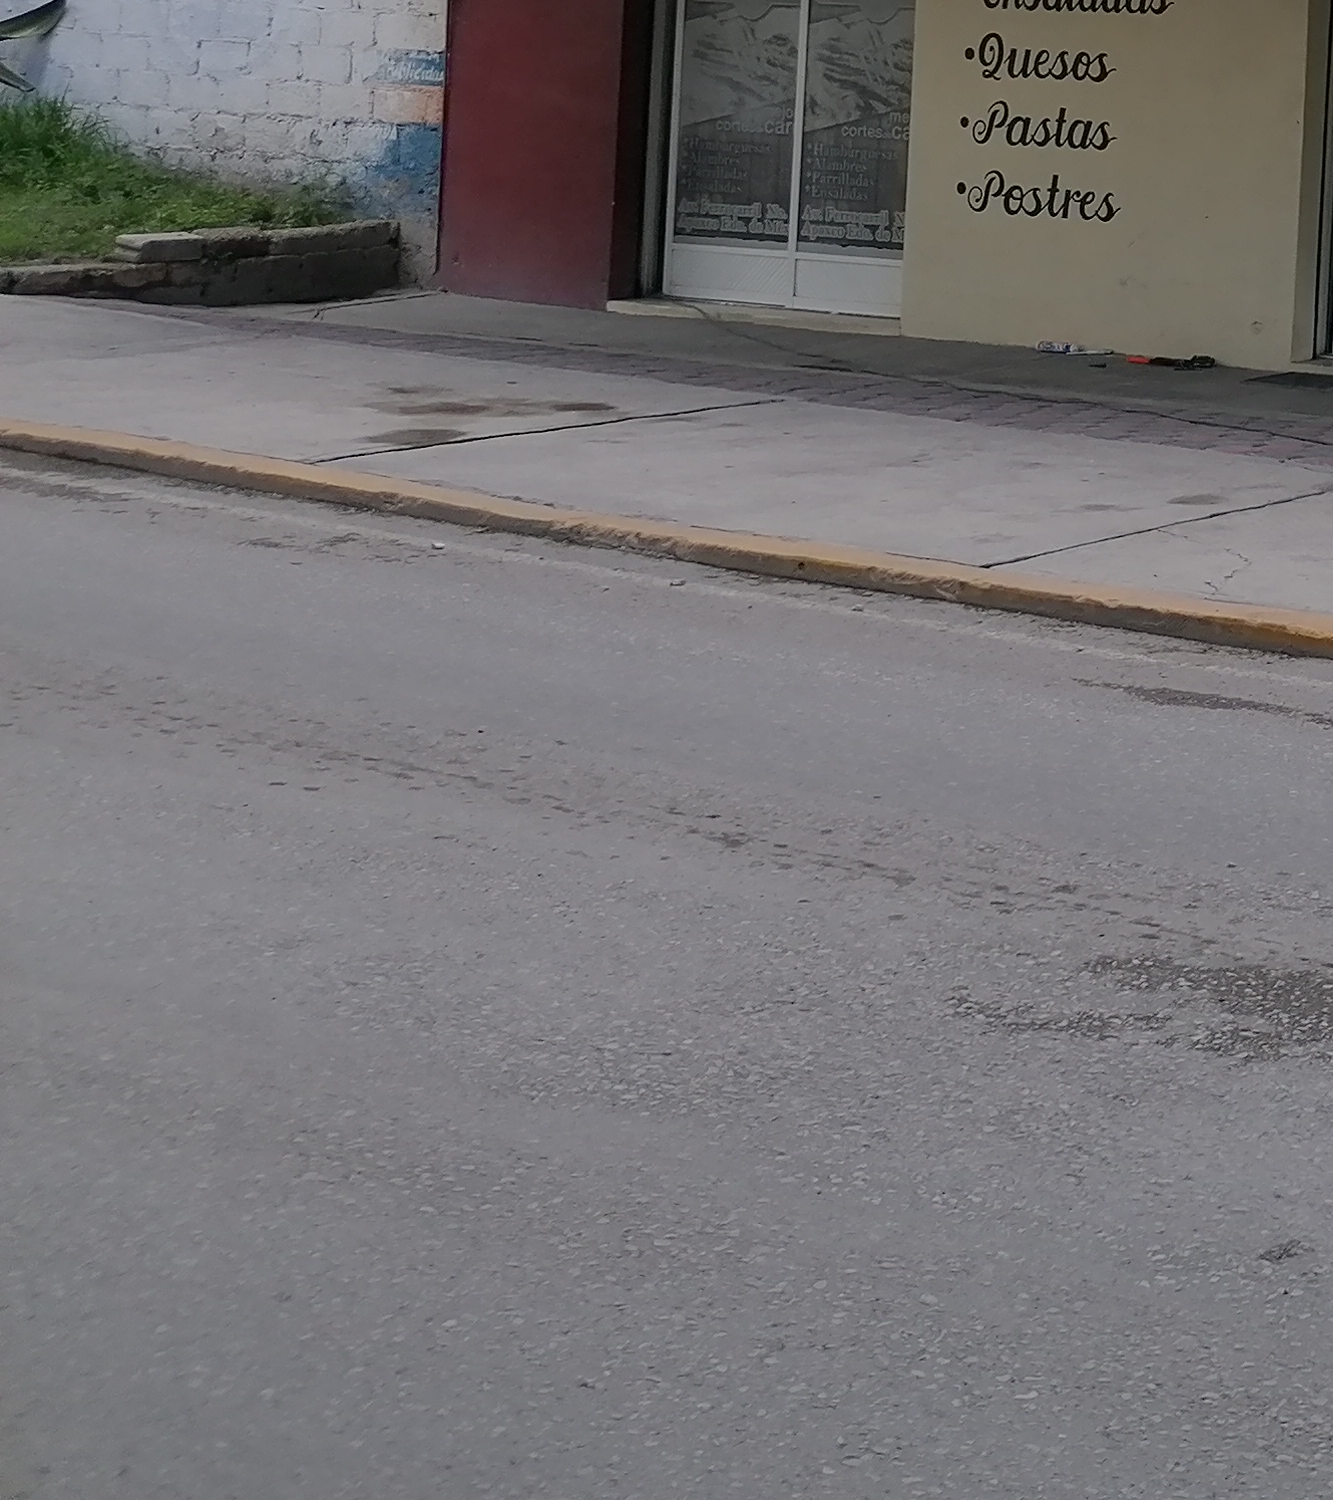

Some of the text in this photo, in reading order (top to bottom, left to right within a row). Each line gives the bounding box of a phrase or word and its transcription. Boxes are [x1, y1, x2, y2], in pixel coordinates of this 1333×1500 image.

[978, 32, 1117, 83] Quesos
[841, 125, 882, 139] cortes
[971, 101, 1118, 151] Pastas
[812, 171, 875, 187] Parrilladas
[813, 157, 868, 173] Alambres
[967, 169, 1121, 222] Postres
